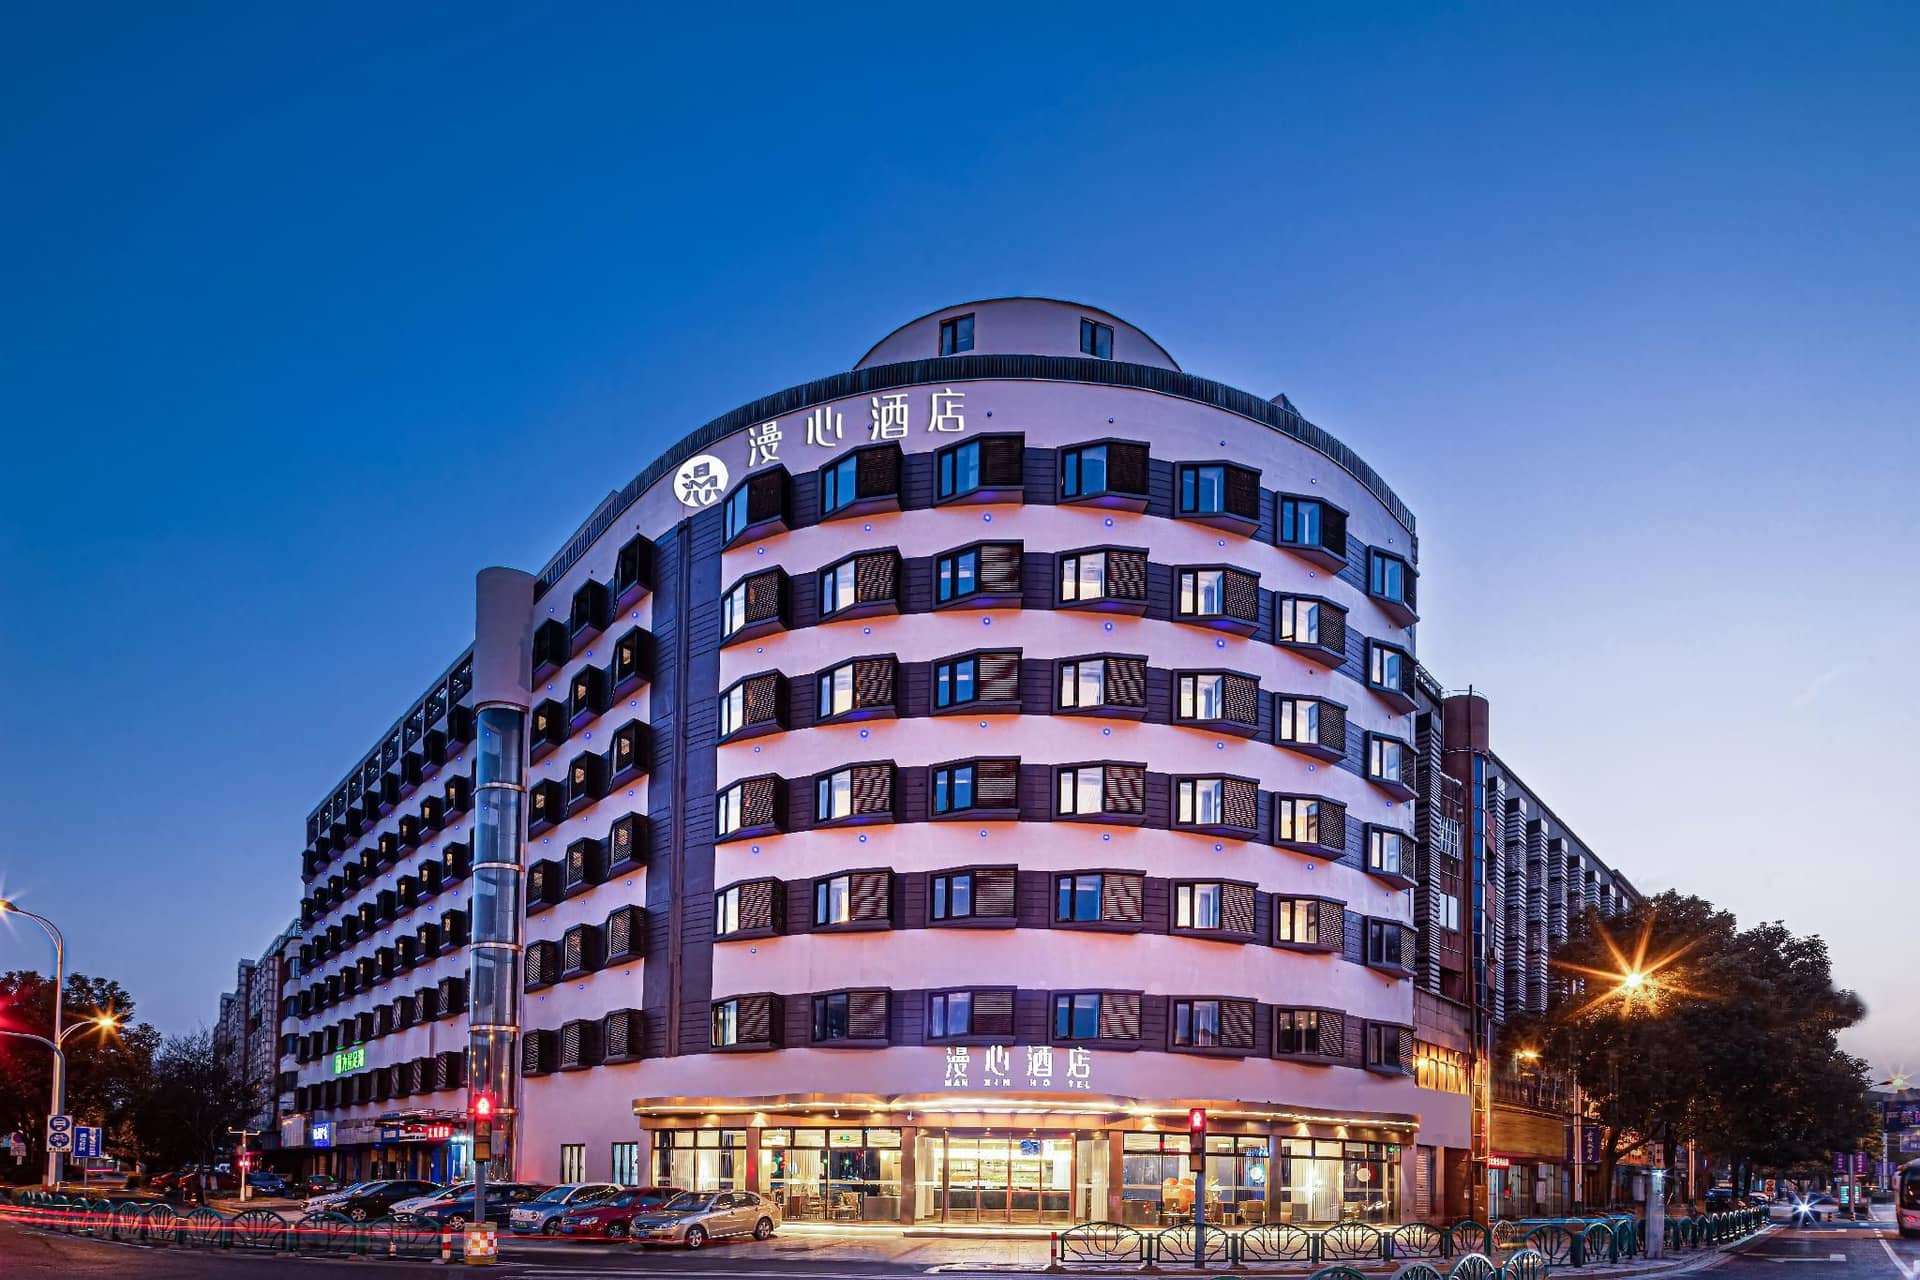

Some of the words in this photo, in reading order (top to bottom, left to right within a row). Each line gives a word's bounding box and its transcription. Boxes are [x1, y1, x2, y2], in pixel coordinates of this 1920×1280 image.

[747, 387, 966, 468] 漫心酒店
[945, 1045, 1091, 1078] 漫心酒店
[944, 1079, 968, 1088] MAN
